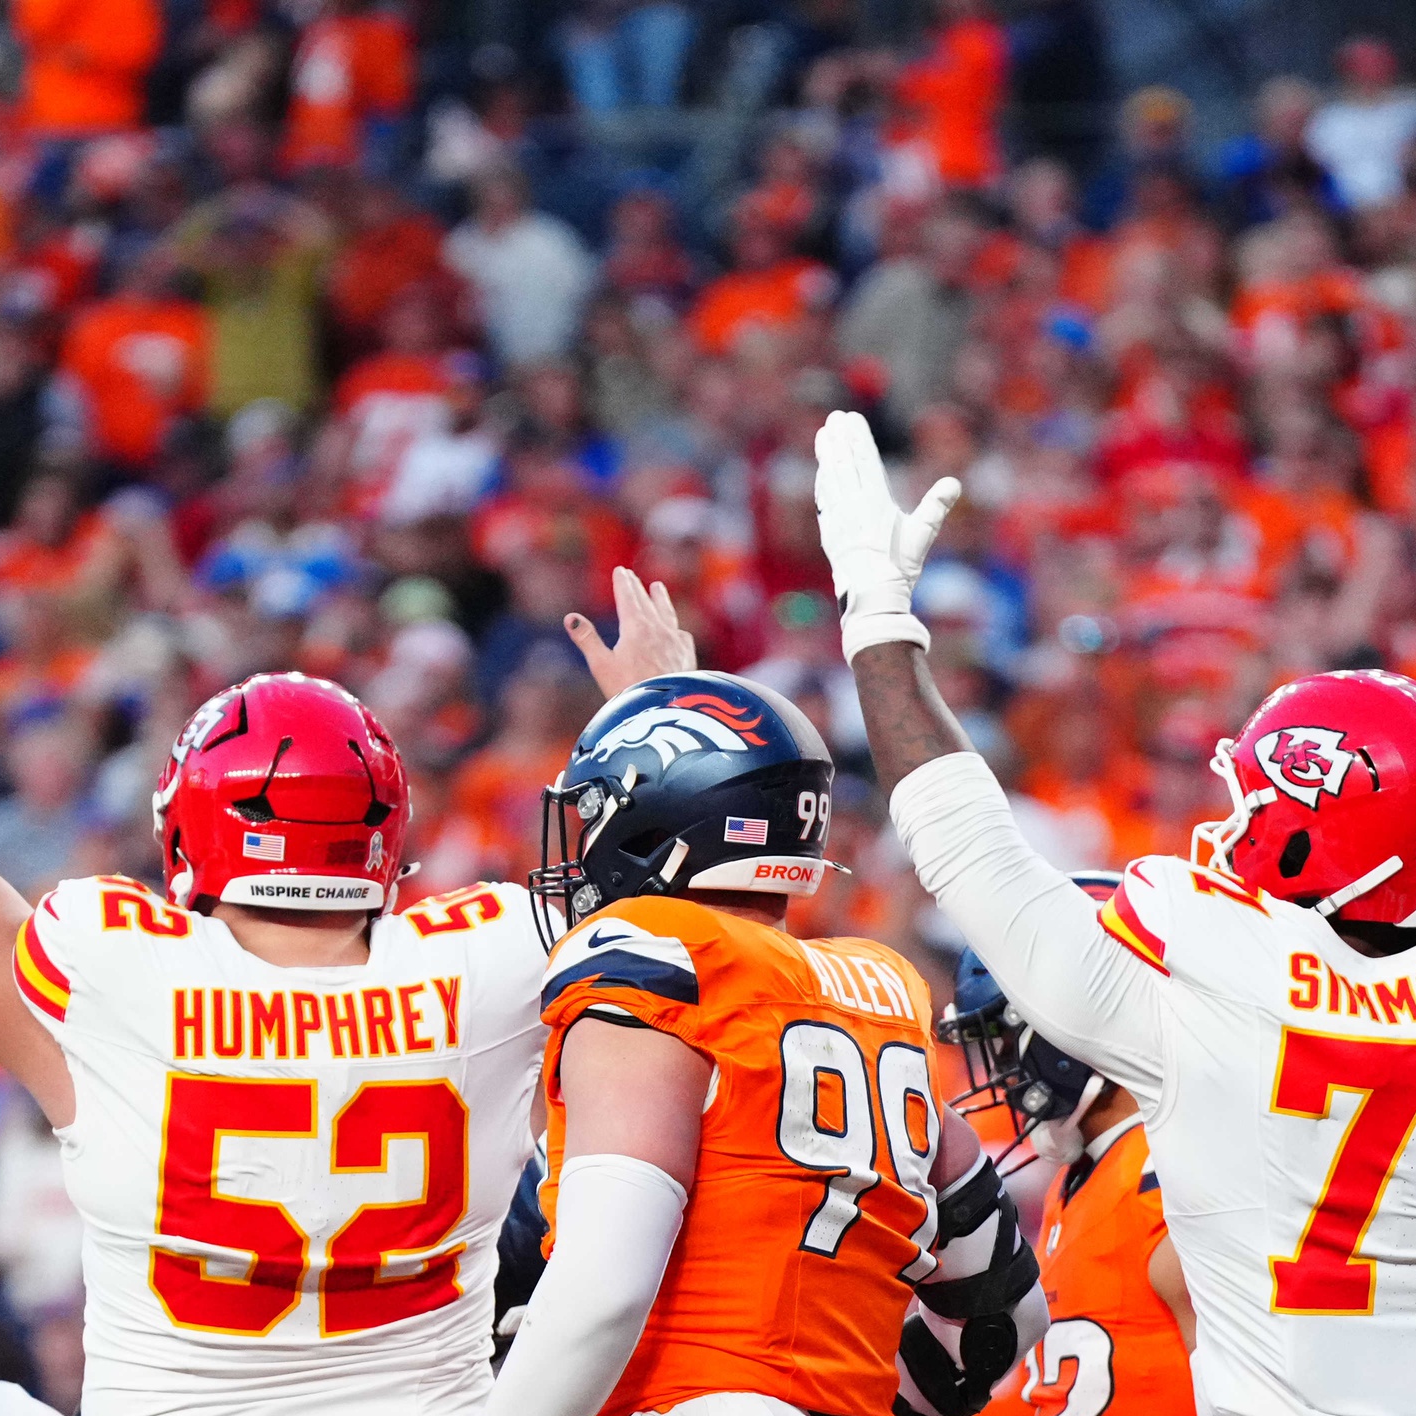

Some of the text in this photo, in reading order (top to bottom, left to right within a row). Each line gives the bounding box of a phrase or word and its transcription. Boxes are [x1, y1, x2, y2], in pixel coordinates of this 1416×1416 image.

[797, 790, 829, 841] 99
[250, 884, 369, 899] INSPIRE CHANGE
[403, 881, 505, 939] 5
[172, 975, 462, 1060] HUMPHREY
[797, 938, 915, 1021] ALLEN
[776, 1019, 941, 1286] 99
[148, 1070, 469, 1338] 52
